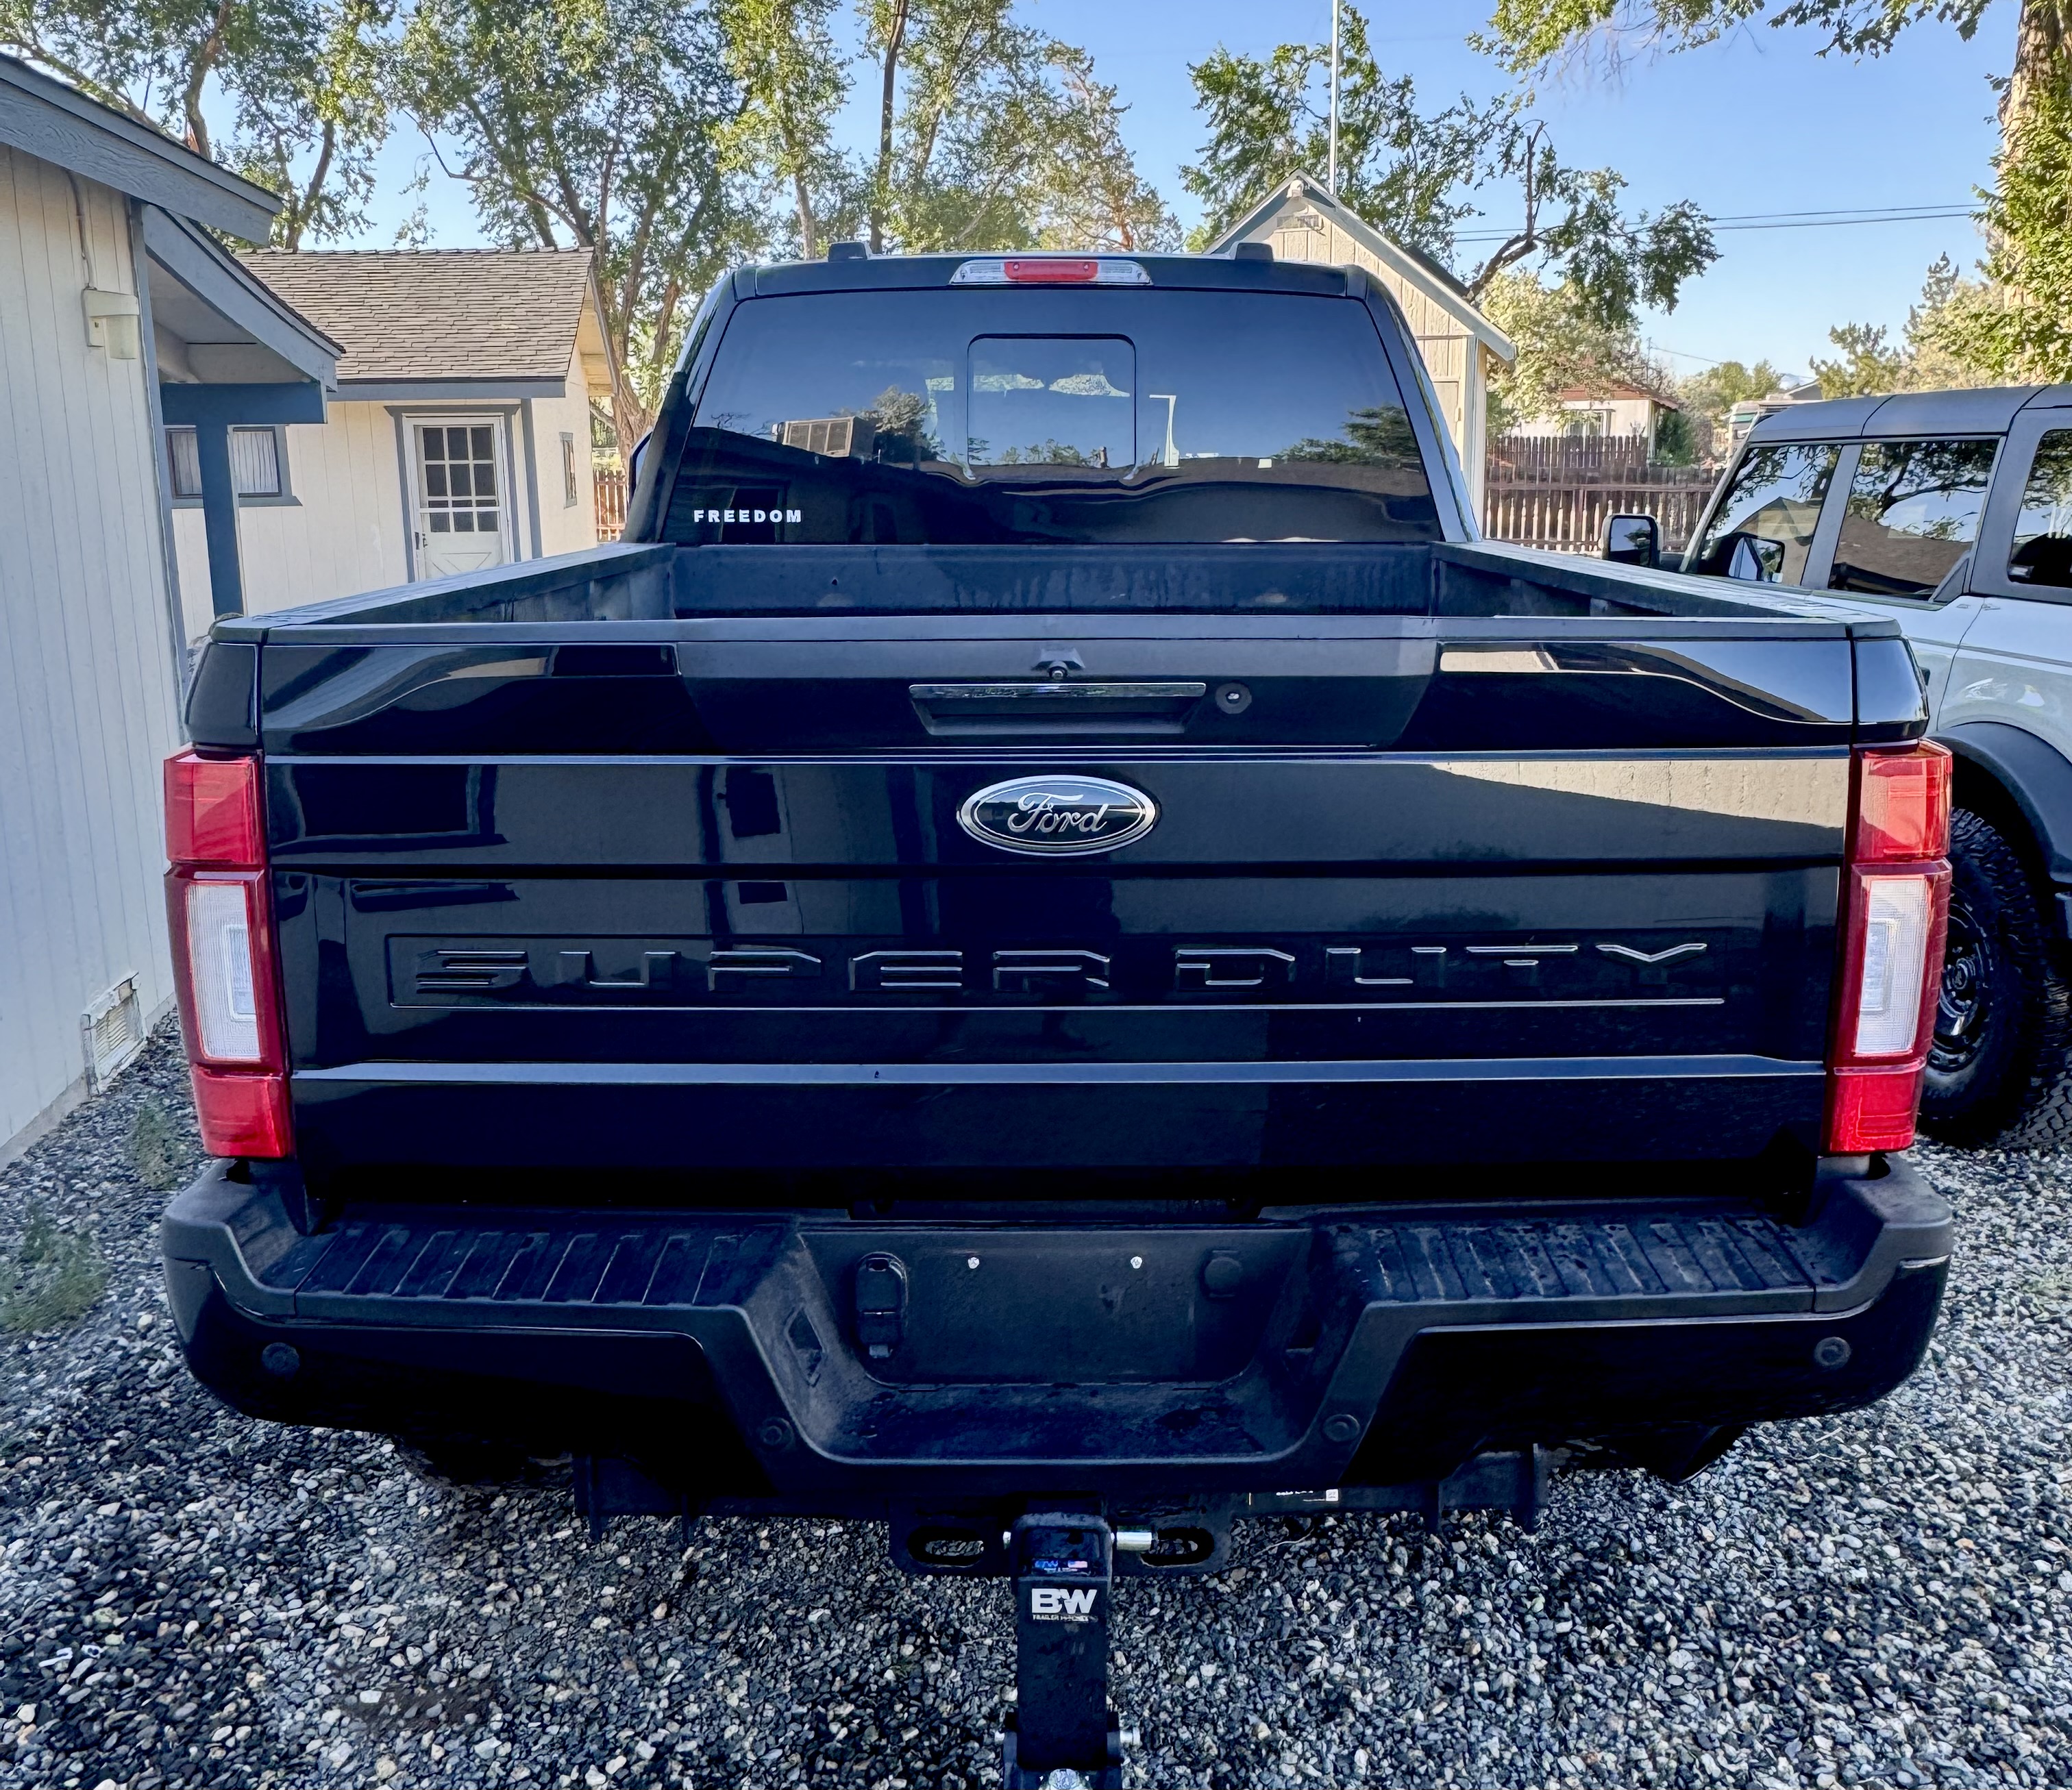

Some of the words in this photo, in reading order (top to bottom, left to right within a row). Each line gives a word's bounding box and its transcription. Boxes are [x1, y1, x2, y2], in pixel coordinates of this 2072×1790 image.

[693, 509, 802, 523] FREEDOM
[1007, 792, 1109, 834] Ford
[416, 948, 1112, 994] SUPER
[1174, 941, 1708, 992] DUTY
